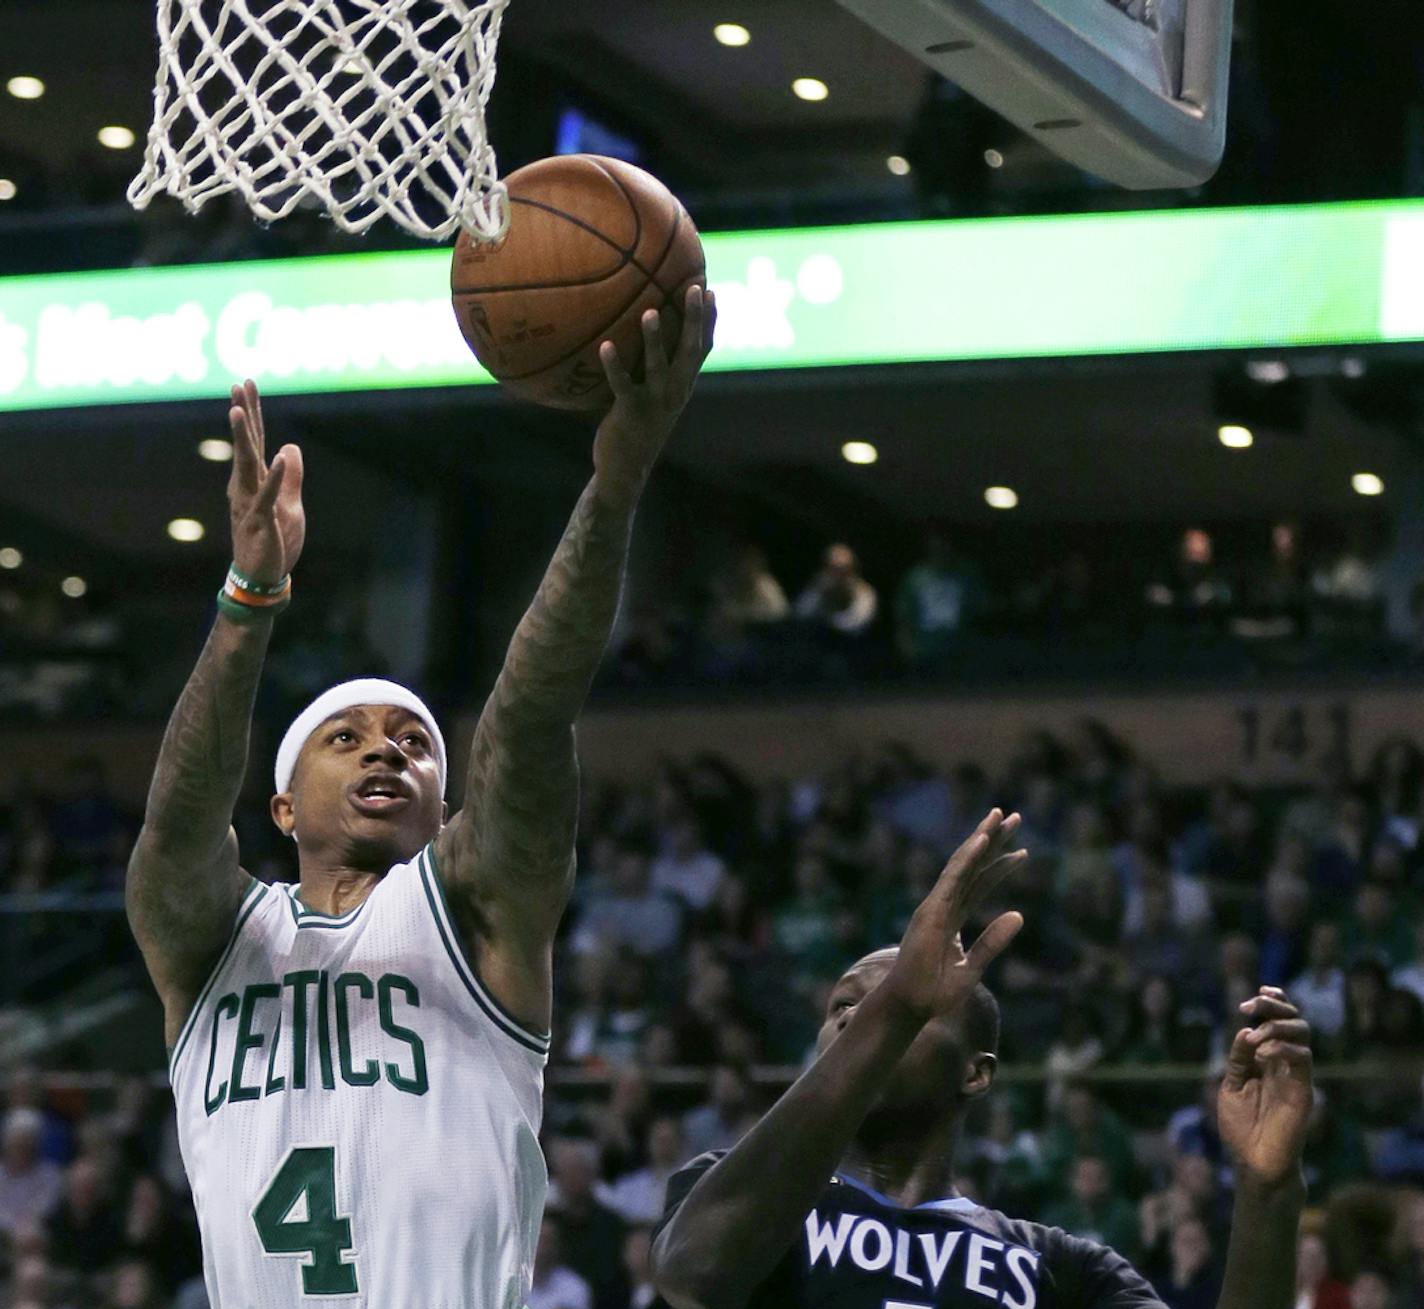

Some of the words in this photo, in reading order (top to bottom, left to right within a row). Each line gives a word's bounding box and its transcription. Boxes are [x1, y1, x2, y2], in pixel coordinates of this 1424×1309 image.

[37, 302, 209, 388] Most
[1238, 703, 1352, 764] 141
[204, 969, 429, 1117] CELTICS
[252, 1146, 358, 1294] 4
